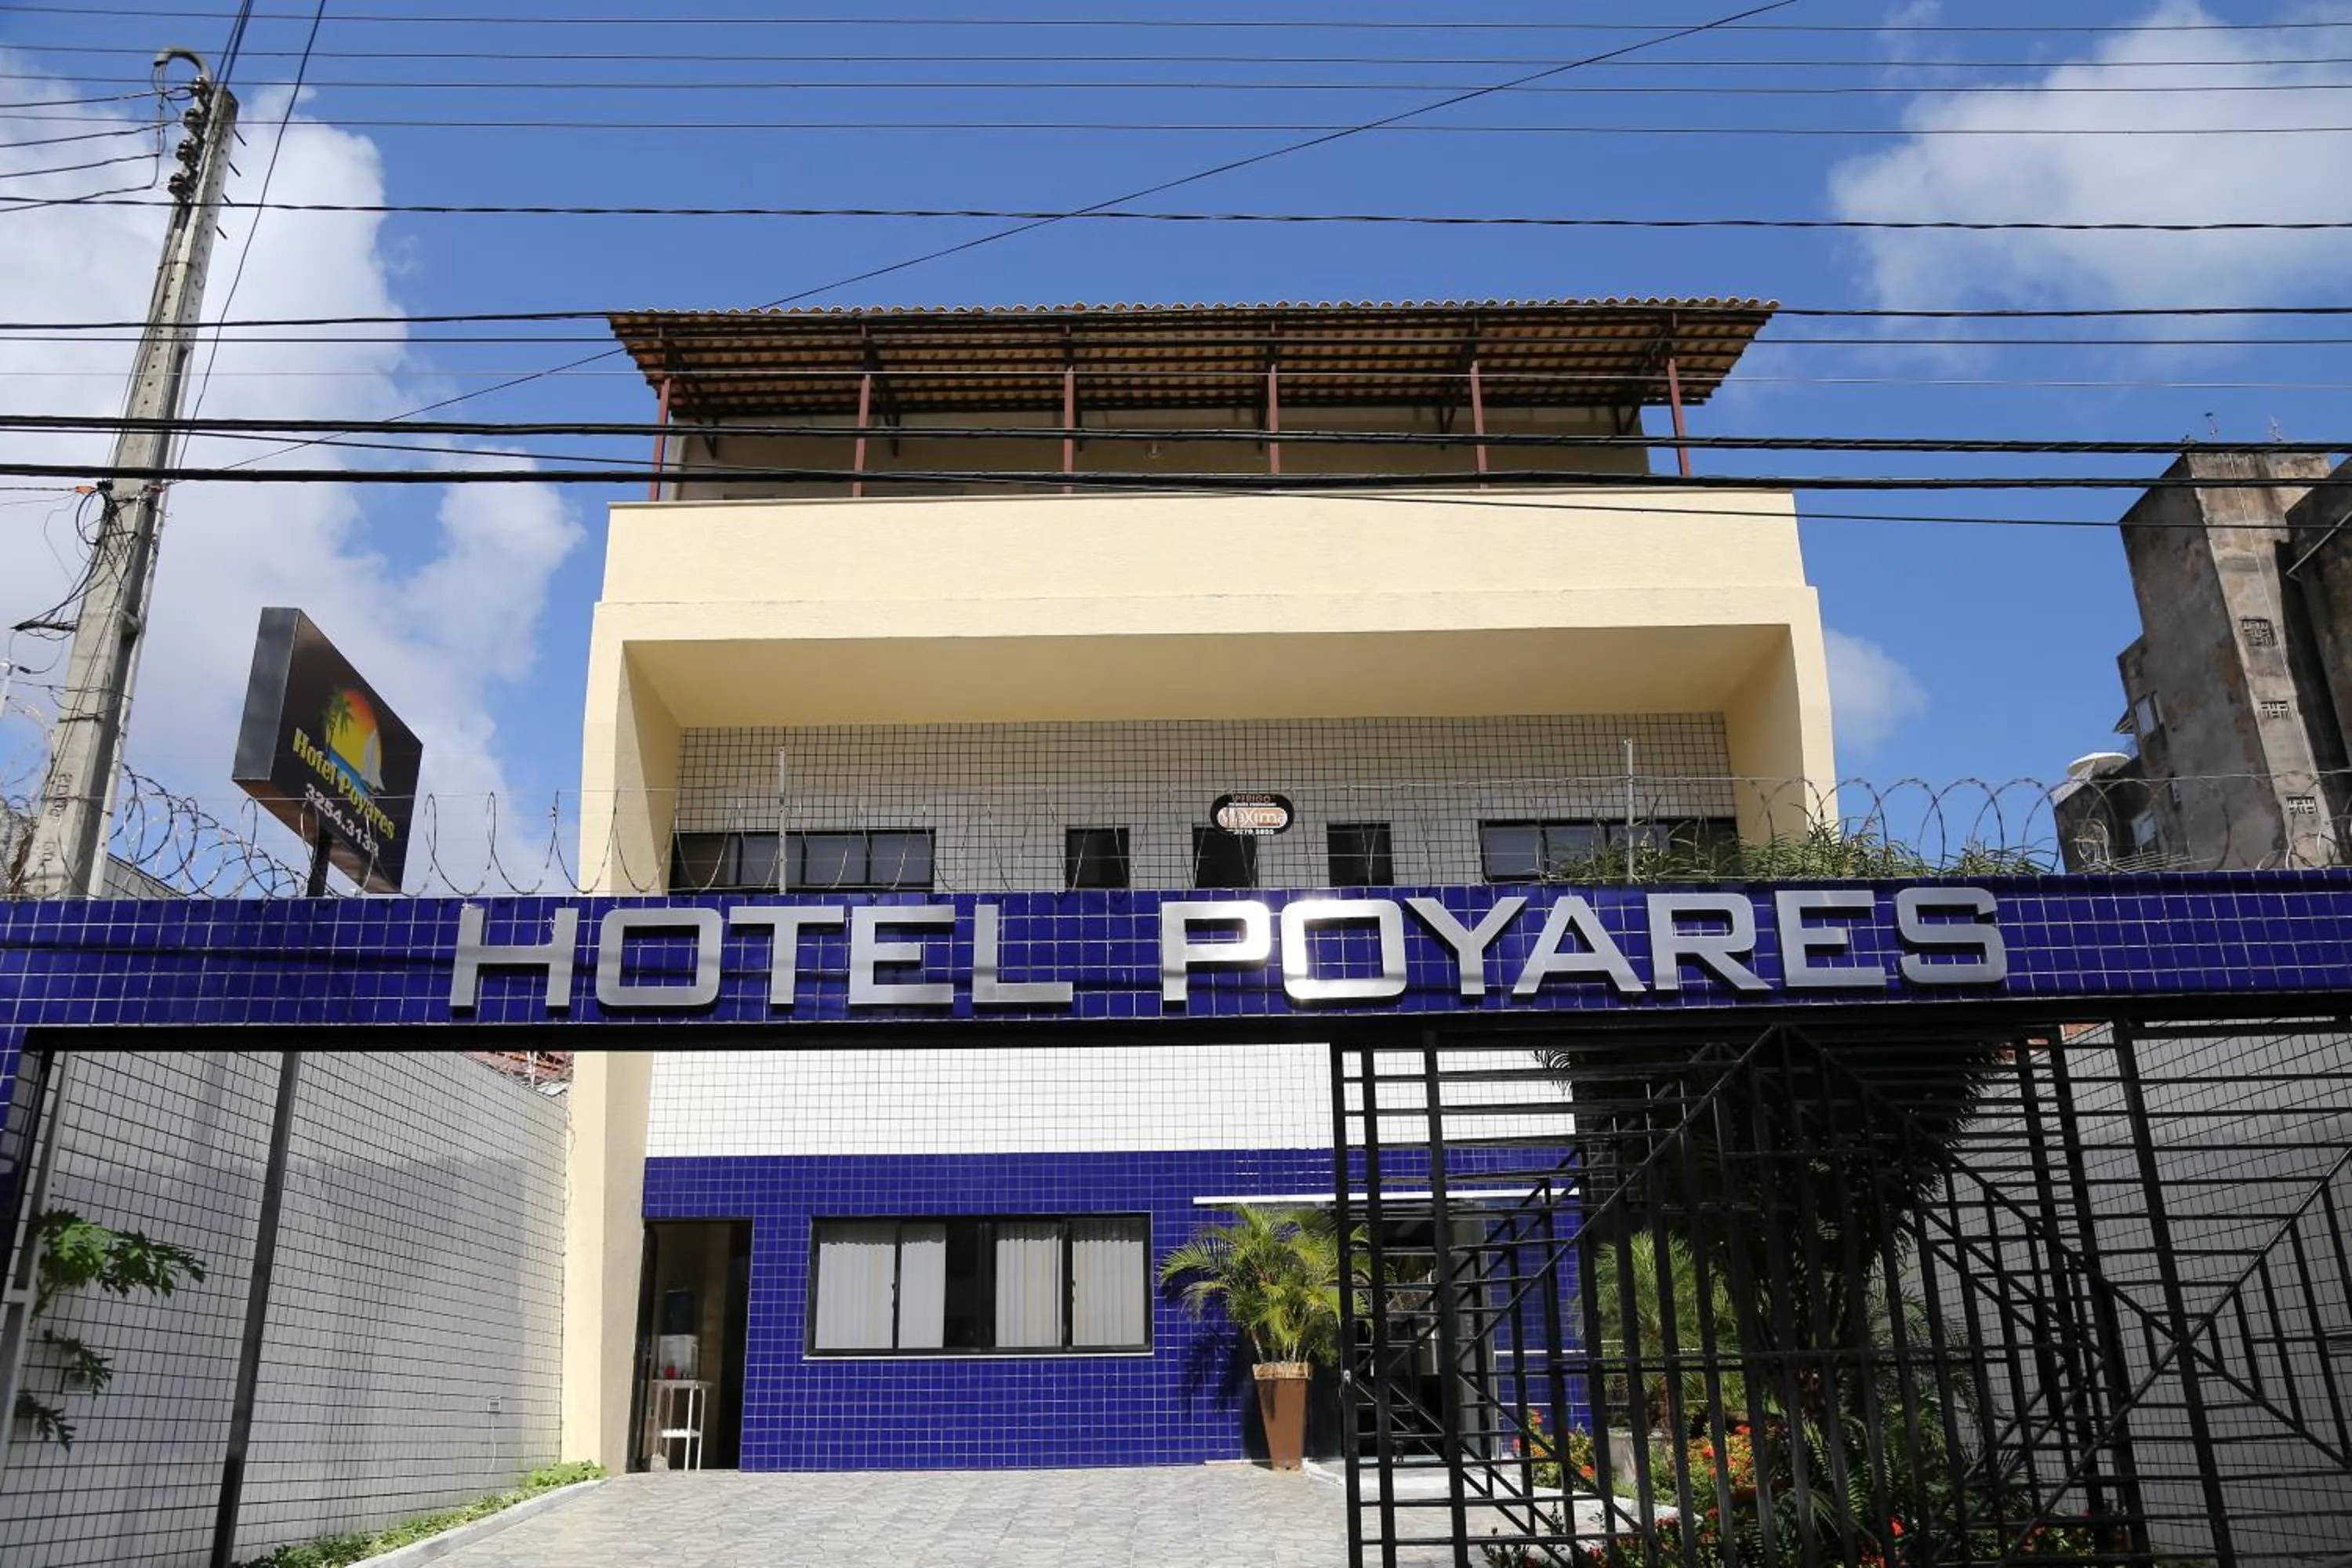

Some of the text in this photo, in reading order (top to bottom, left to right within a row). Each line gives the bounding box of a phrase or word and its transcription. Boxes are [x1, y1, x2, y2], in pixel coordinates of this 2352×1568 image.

[292, 726, 396, 840] Hotel Poyares
[449, 886, 2008, 1010] HOTEL POYARES
